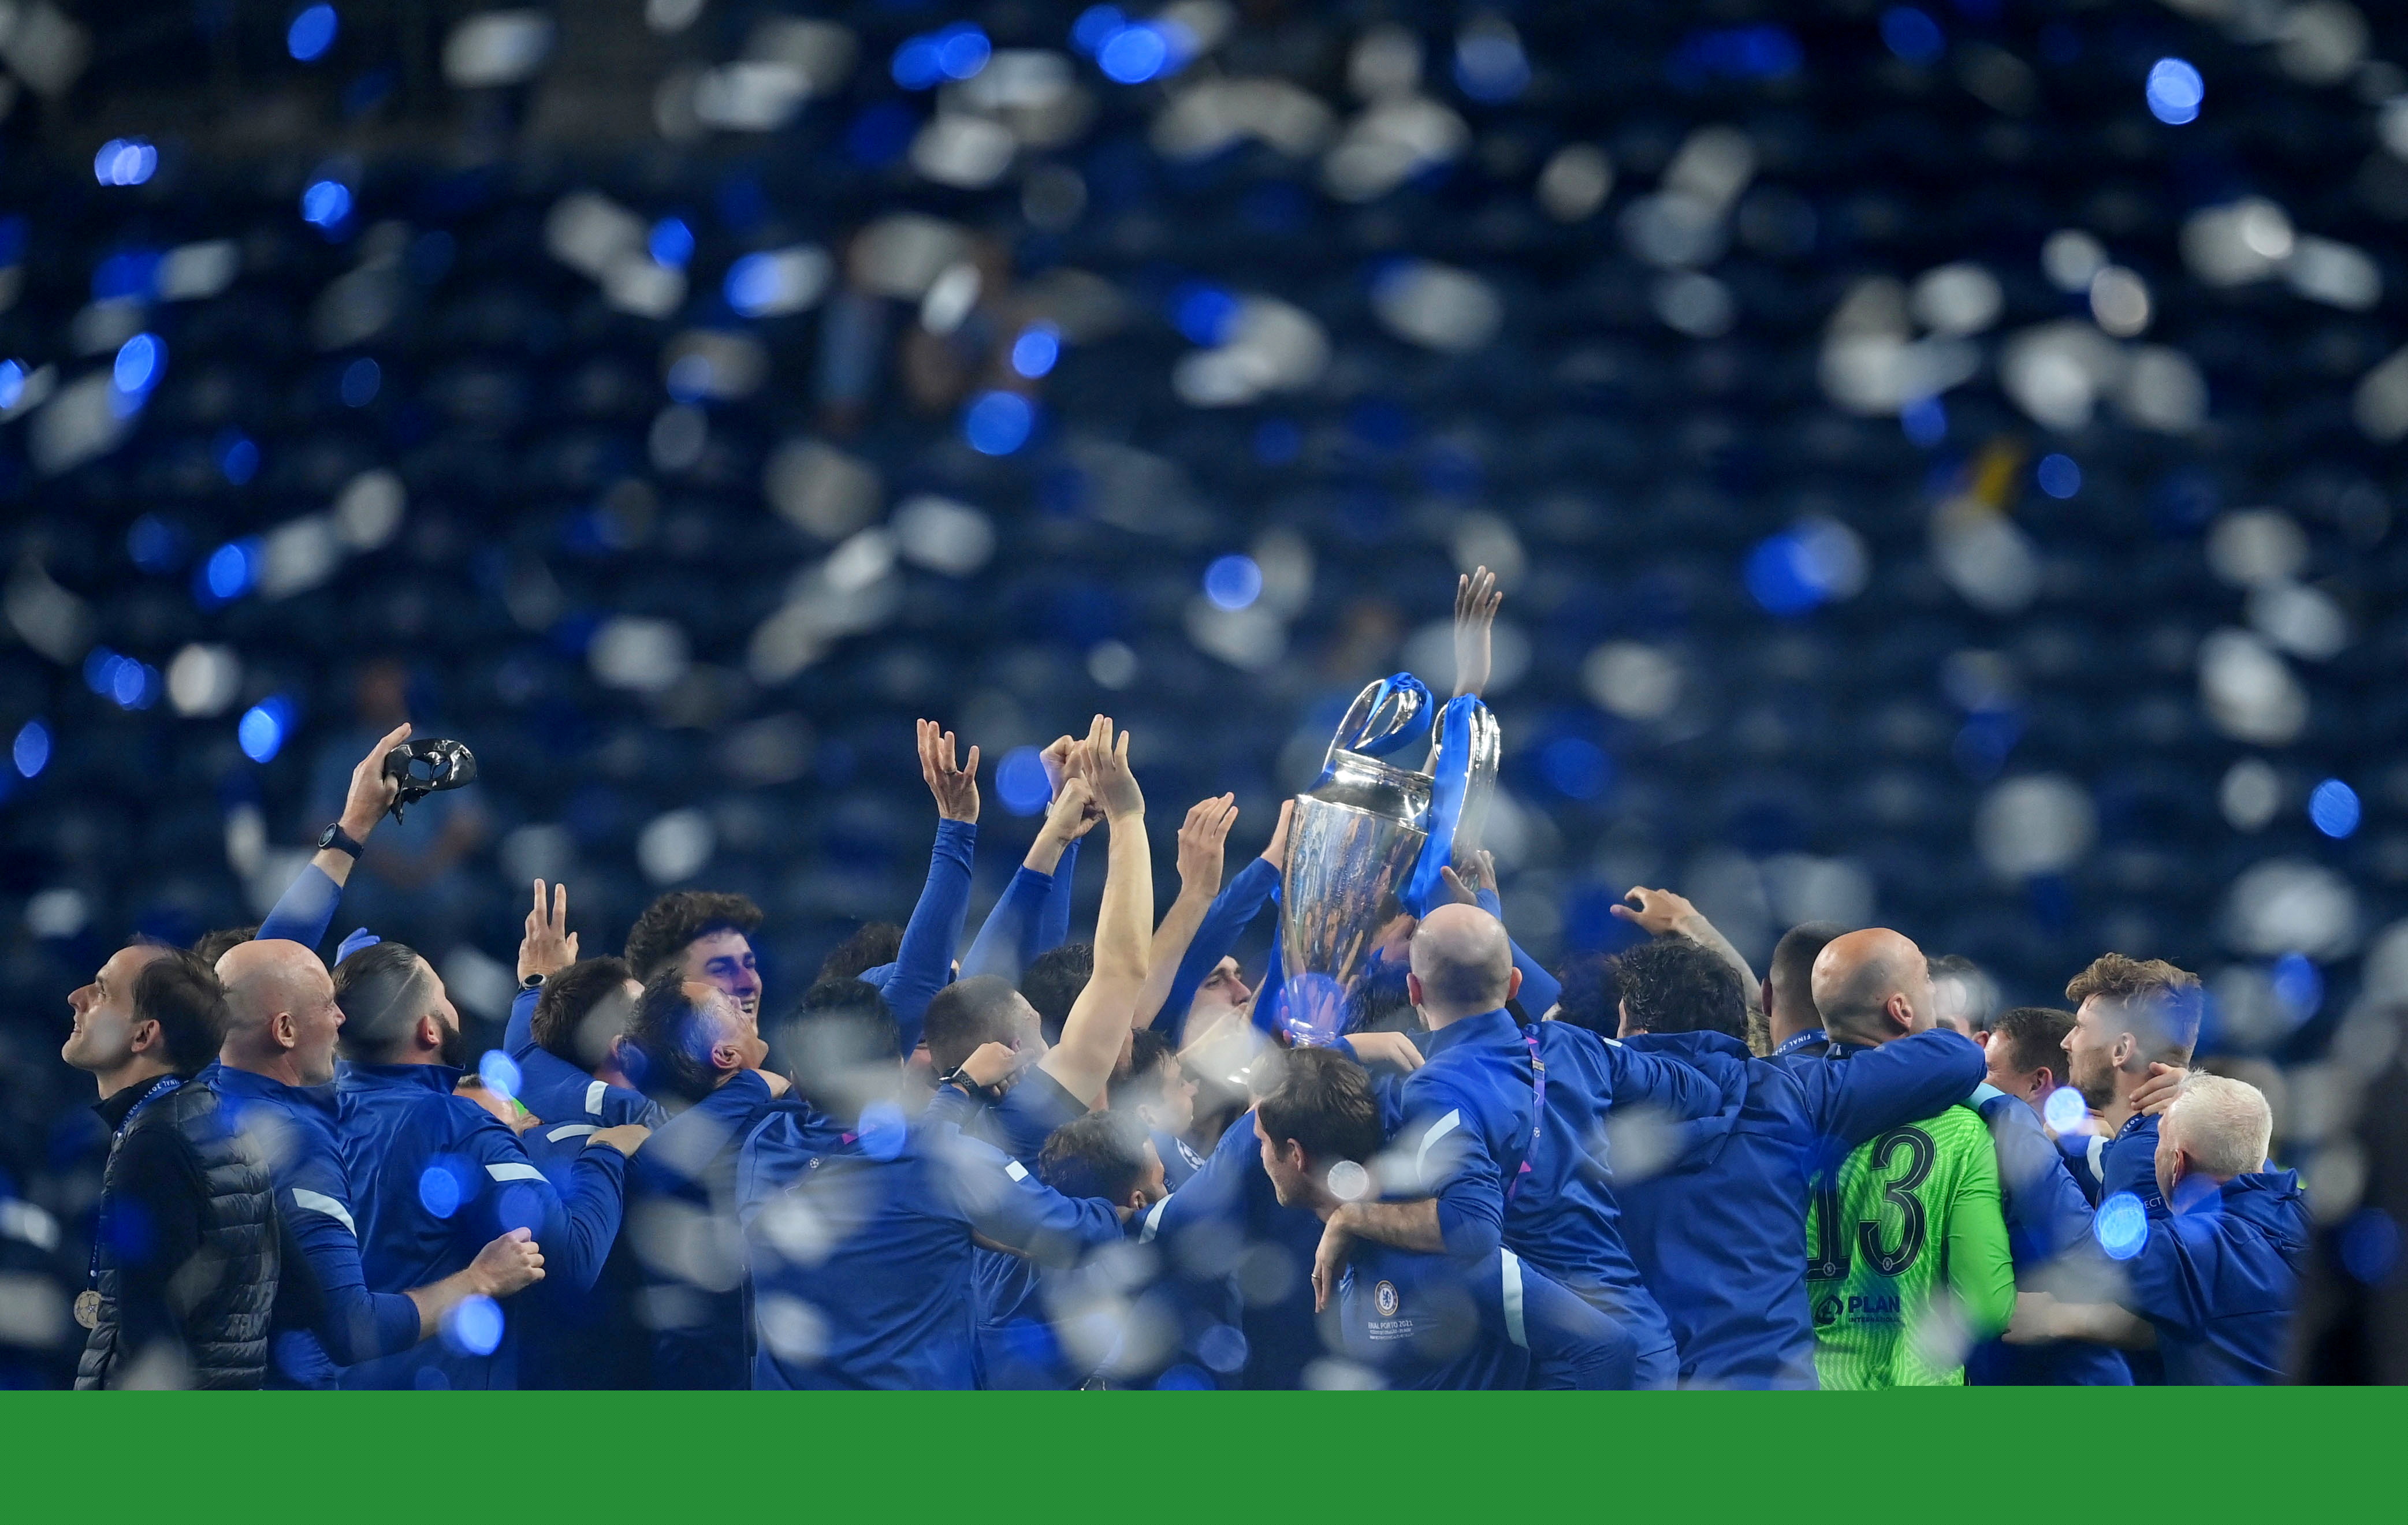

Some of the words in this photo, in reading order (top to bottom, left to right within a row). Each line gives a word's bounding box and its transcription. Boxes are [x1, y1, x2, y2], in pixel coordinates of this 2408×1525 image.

[1789, 1033, 1811, 1047] FINAL
[1164, 1178, 1176, 1191] 021
[1806, 1124, 1937, 1282] 13
[2143, 1196, 2161, 1209] ECT
[1848, 1296, 1900, 1313] PLAN
[1380, 1321, 1398, 1329] PORTO
